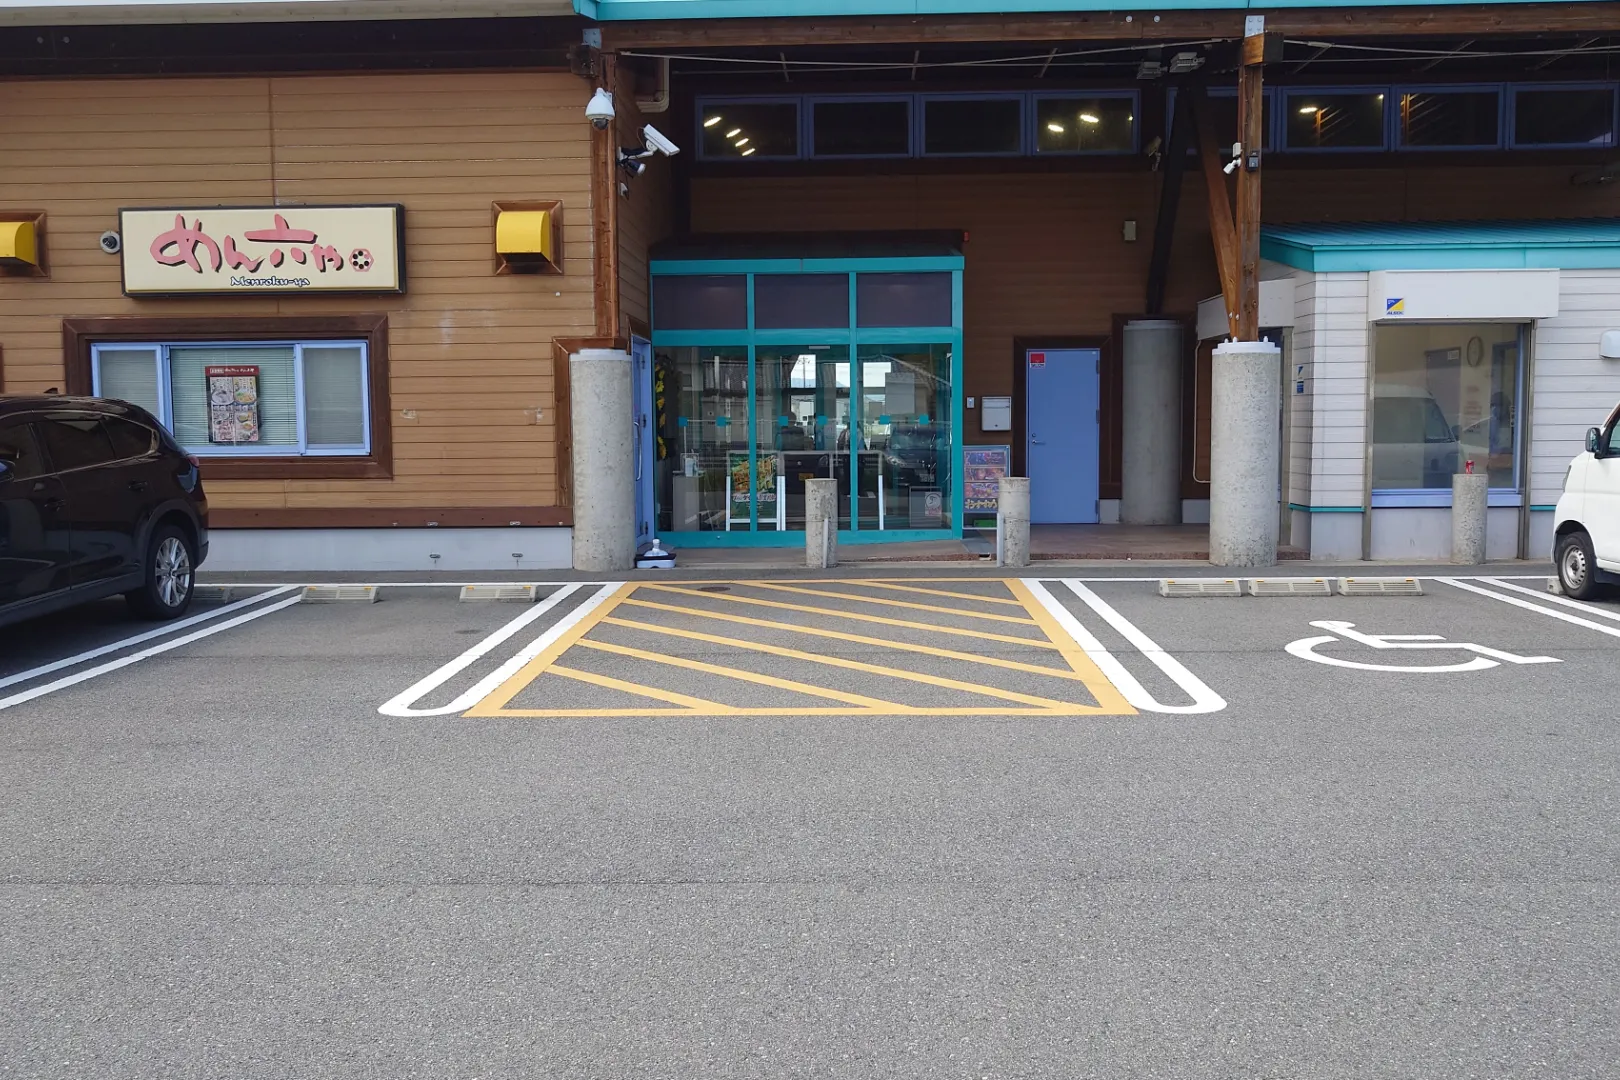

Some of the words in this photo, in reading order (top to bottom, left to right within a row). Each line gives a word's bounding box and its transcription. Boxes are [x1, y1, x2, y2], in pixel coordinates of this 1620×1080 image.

[149, 213, 344, 273] めん六や
[230, 276, 310, 287] Menroku-ya
